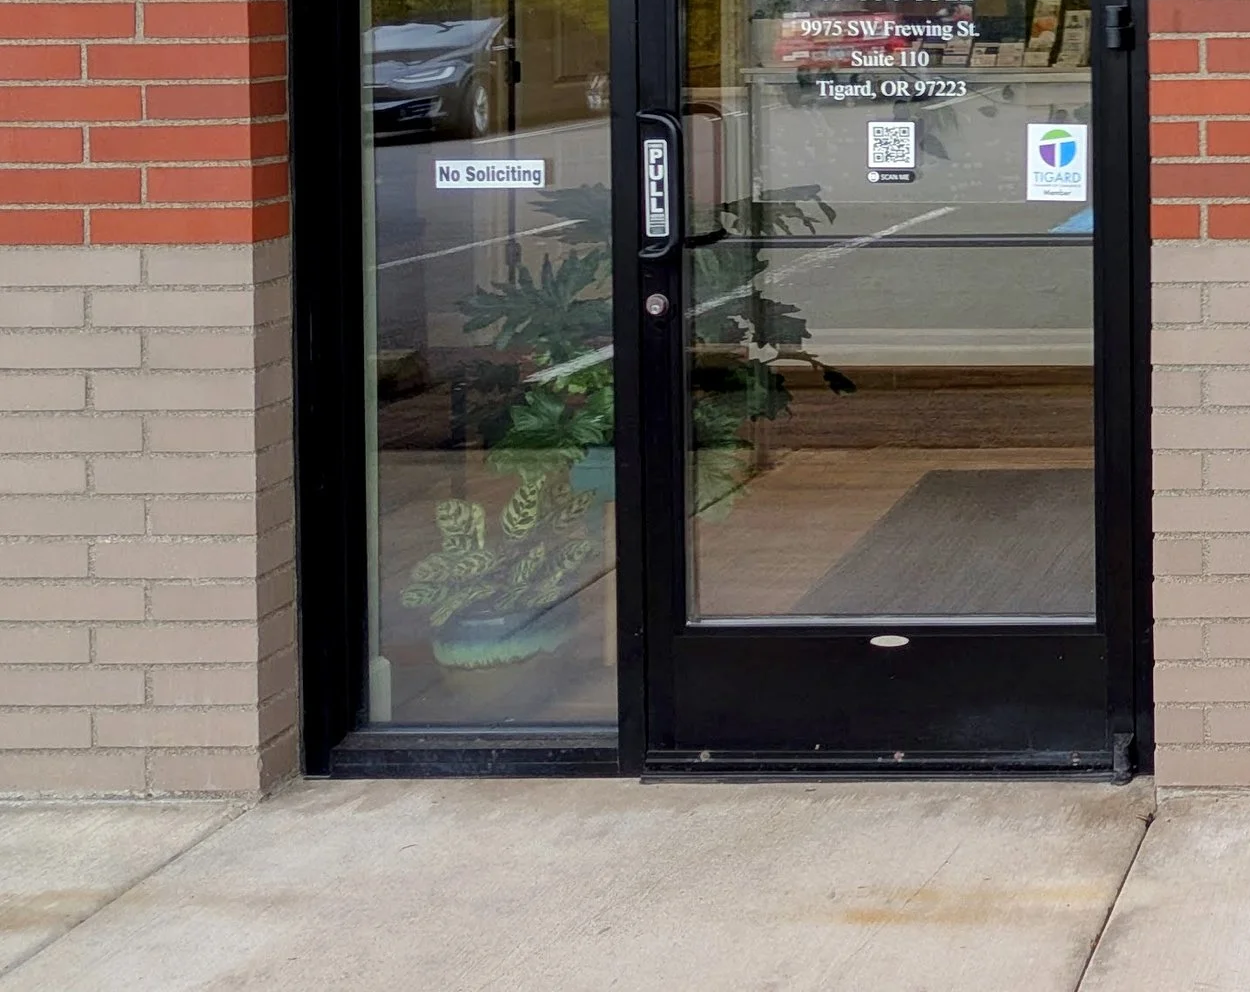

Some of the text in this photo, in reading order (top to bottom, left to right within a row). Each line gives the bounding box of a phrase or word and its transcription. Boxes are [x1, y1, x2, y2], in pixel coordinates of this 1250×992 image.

[801, 19, 980, 40] 9975 SW Frewing St.
[851, 51, 929, 68] Suite 110
[816, 80, 967, 99] Tigard, OR 97223
[438, 166, 542, 186] No Soliciting
[648, 148, 664, 213] PULL
[1033, 171, 1082, 184] TIGARD
